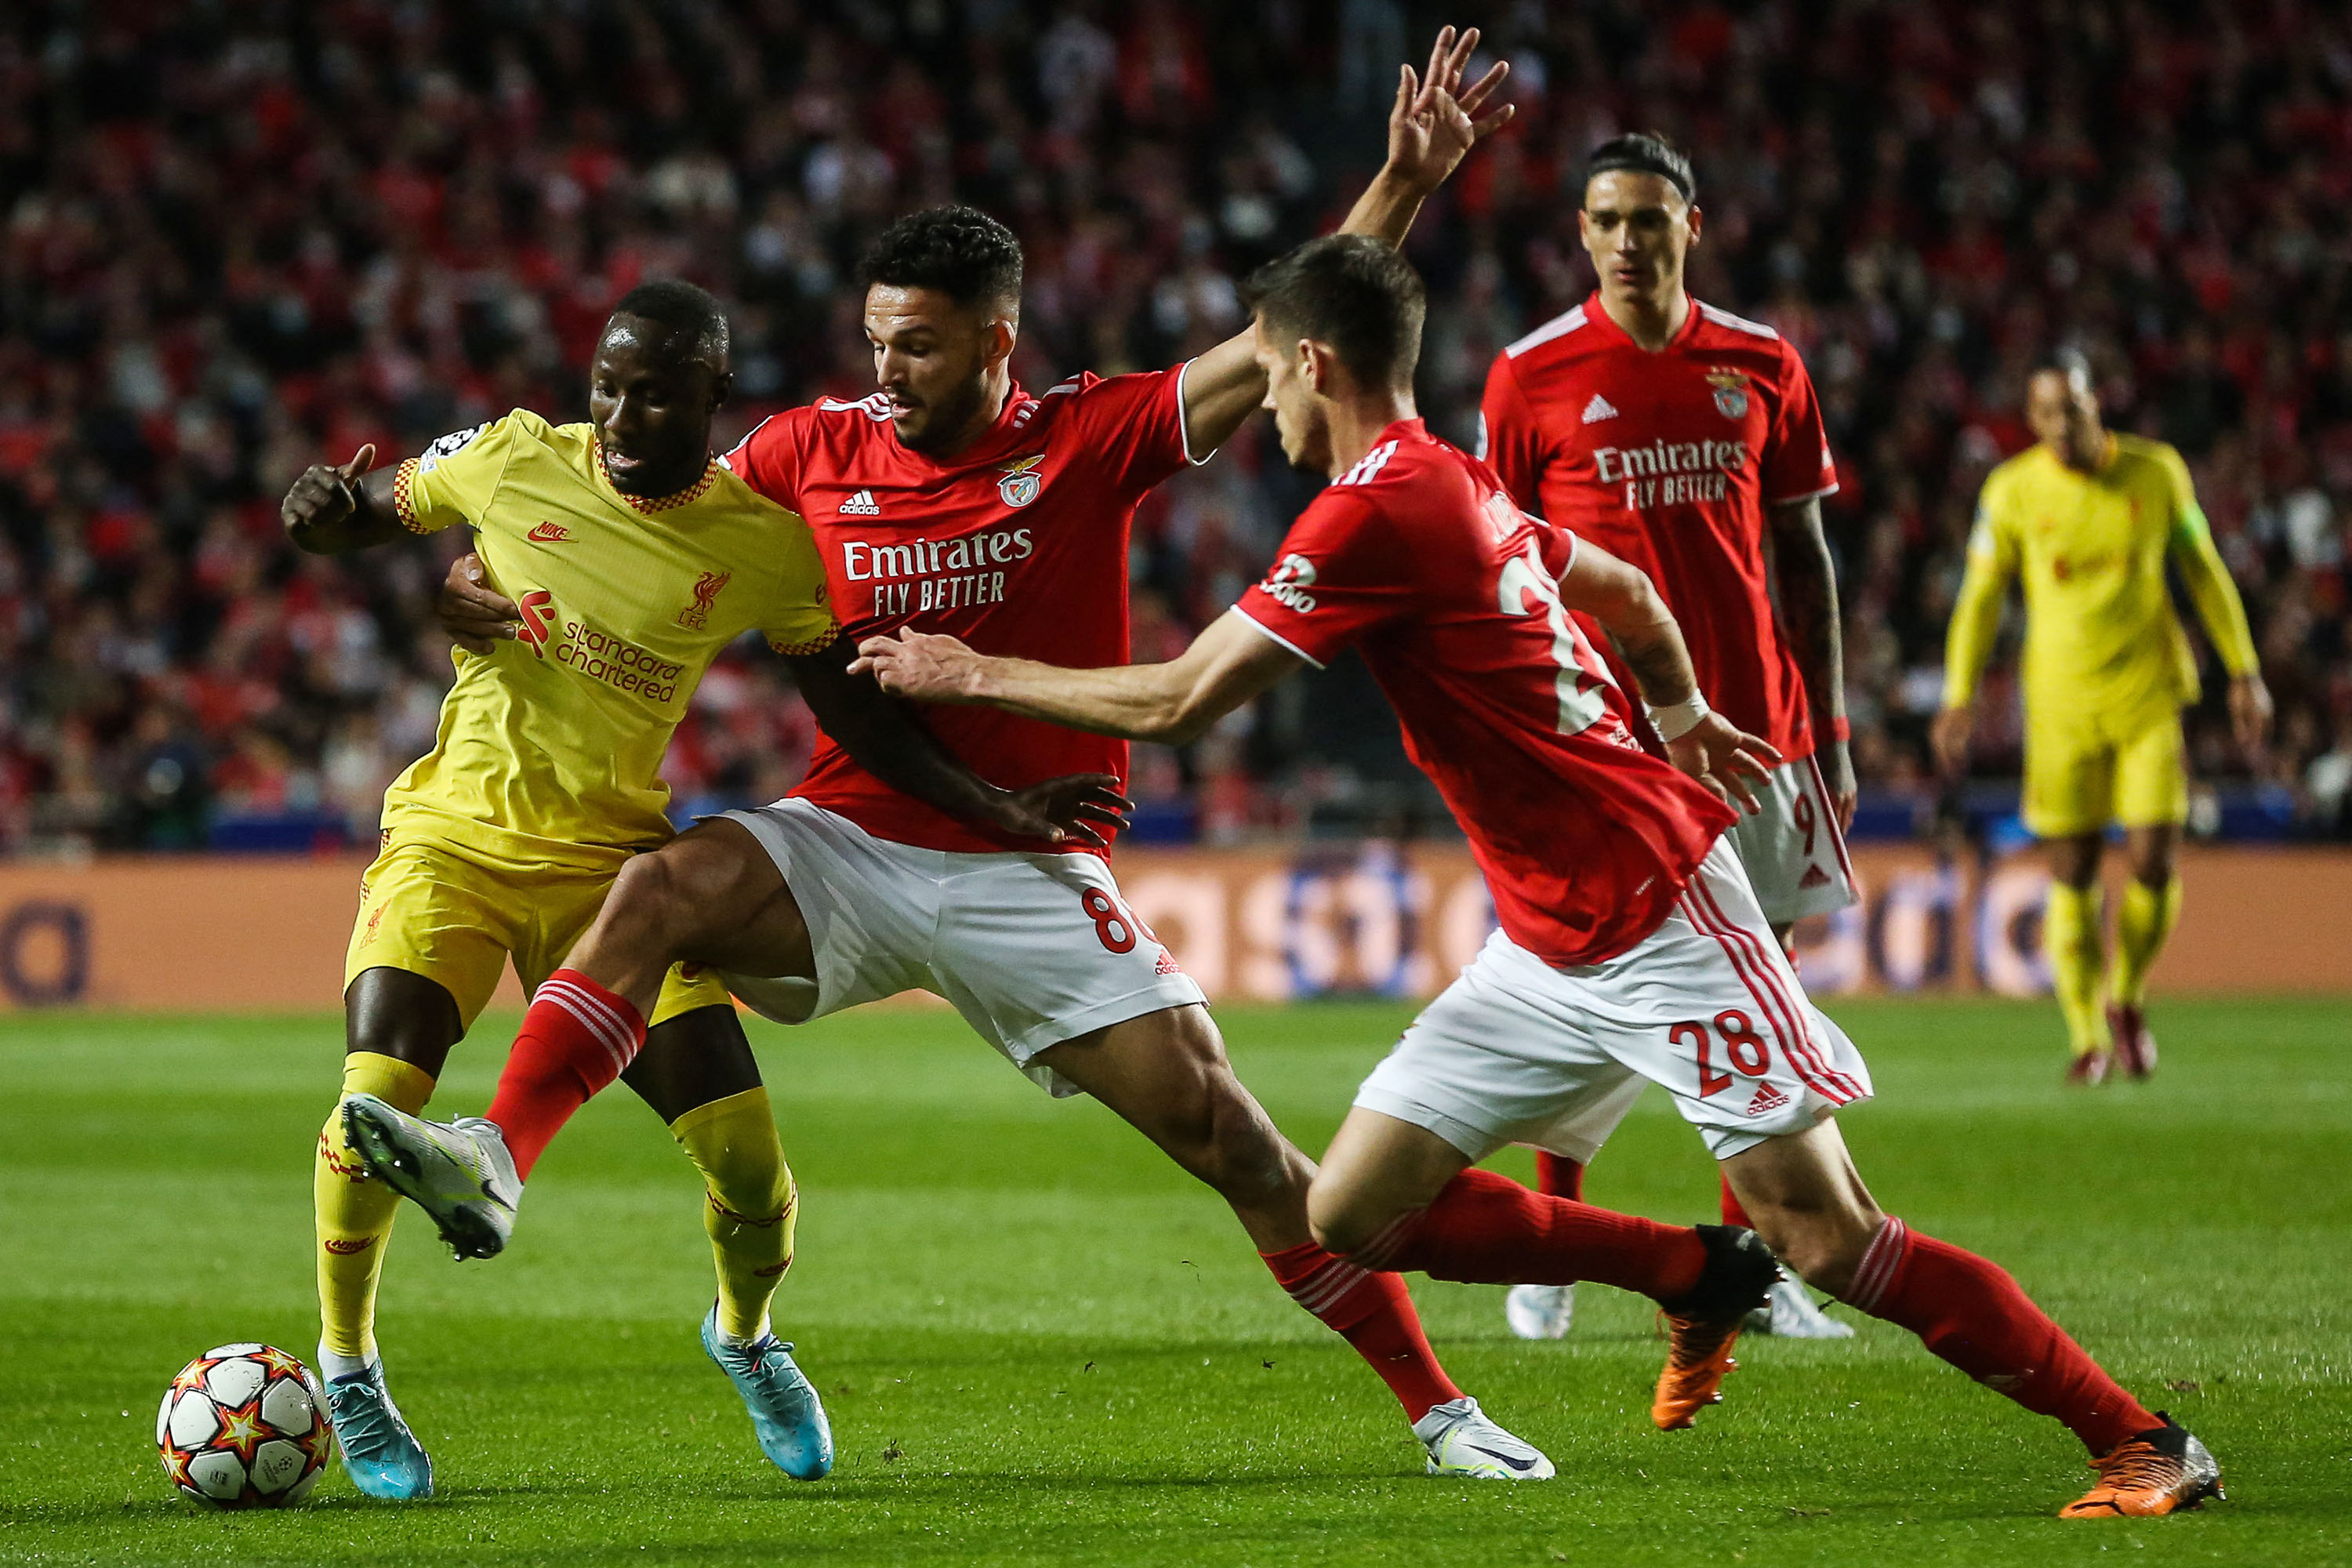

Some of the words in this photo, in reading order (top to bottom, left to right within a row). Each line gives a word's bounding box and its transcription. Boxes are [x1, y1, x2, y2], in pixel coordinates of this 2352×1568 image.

[1593, 437, 1747, 484] Emirates
[839, 503, 880, 515] adidas
[1625, 479, 1656, 511] FLY
[1663, 473, 1726, 506] BETTER
[536, 521, 569, 539] NIKE
[842, 528, 1033, 581] Emirates
[874, 583, 909, 617] FLY
[920, 571, 1004, 612] BETTER
[678, 612, 706, 631] LFC
[556, 643, 677, 703] chartered
[563, 622, 684, 681] standard
[1794, 792, 1816, 857] 9
[1669, 1009, 1771, 1099] 28
[1748, 1094, 1790, 1115] adidas
